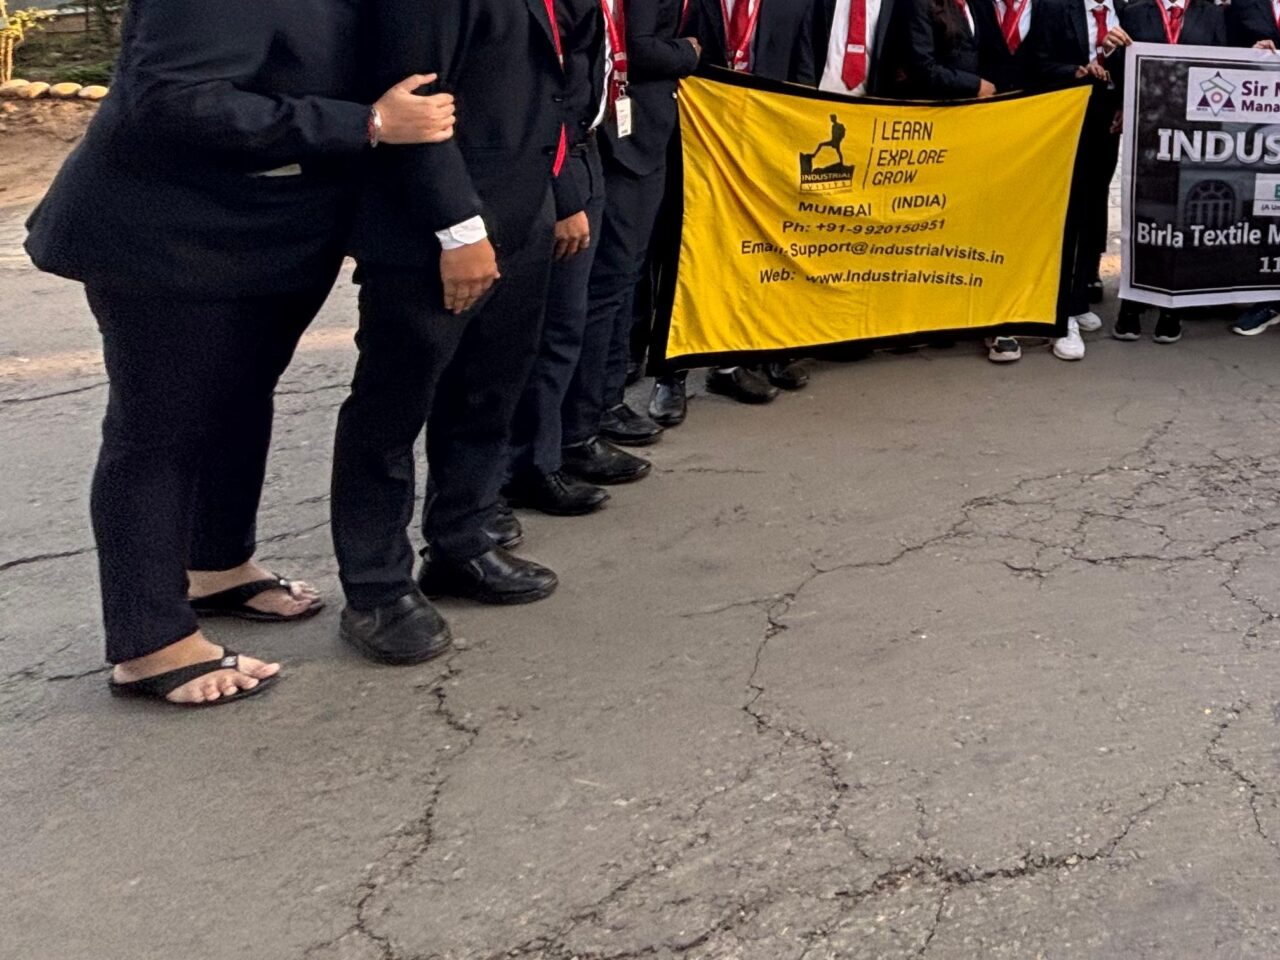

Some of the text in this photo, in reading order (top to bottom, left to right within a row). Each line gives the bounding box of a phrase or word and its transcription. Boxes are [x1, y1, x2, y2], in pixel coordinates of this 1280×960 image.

[1241, 80, 1268, 97] Sir
[882, 121, 933, 140] LEARN
[877, 149, 948, 166] EXPLORE
[872, 169, 918, 186] GROW
[799, 193, 946, 217] MUMBAI (INDIA)
[782, 221, 810, 233] Ph:
[1137, 221, 1183, 248] Birla
[1190, 222, 1262, 246] Textile
[760, 267, 796, 284] Web:
